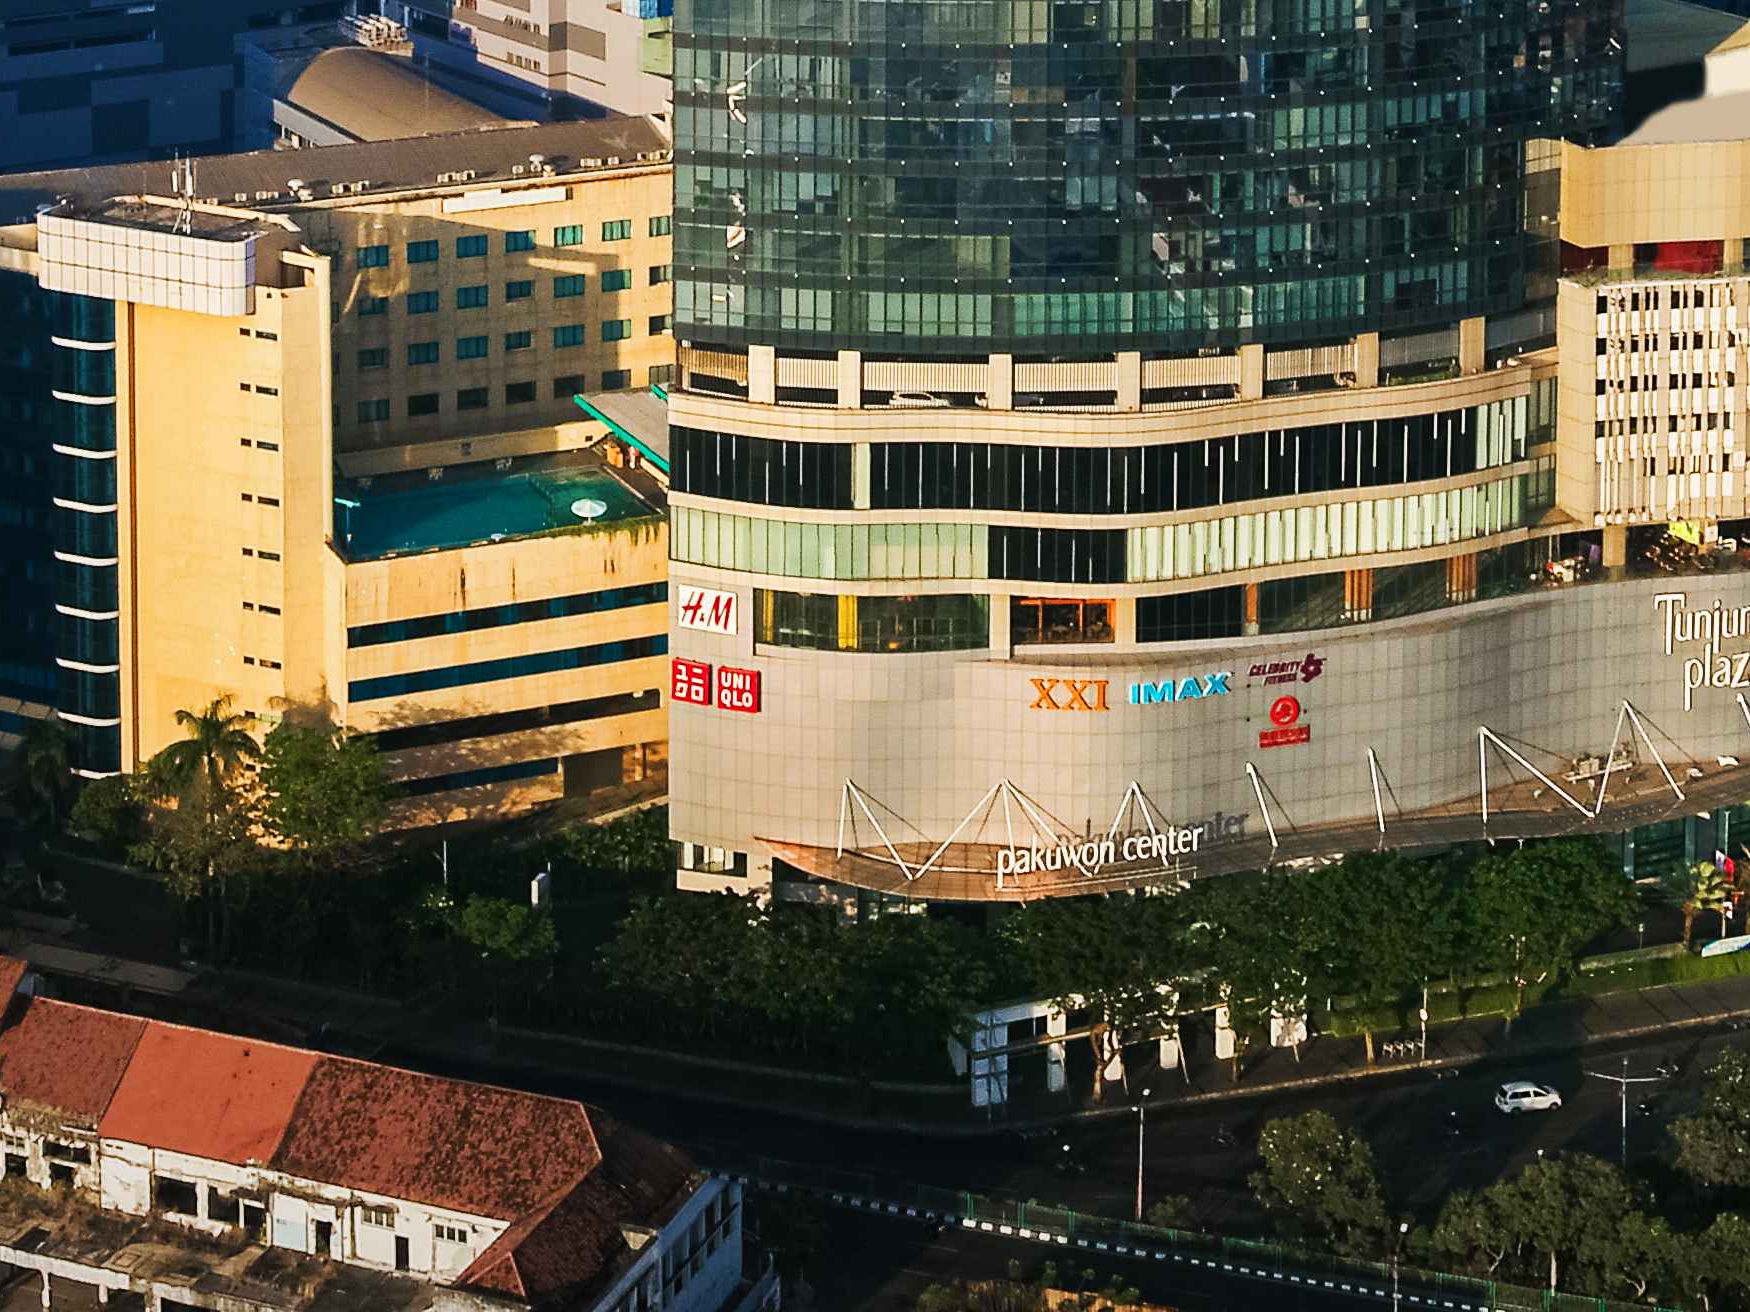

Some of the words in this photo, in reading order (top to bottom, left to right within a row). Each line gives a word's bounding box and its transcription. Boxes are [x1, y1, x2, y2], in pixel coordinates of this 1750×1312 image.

[681, 591, 733, 631] H&M
[720, 671, 752, 690] UNI
[1248, 660, 1302, 677] CELEBRITY
[720, 688, 753, 708] QLO
[1029, 678, 1111, 712] XXI
[1128, 671, 1232, 705] IMAX
[996, 834, 1115, 889] pakuwon
[1122, 826, 1204, 862] center
